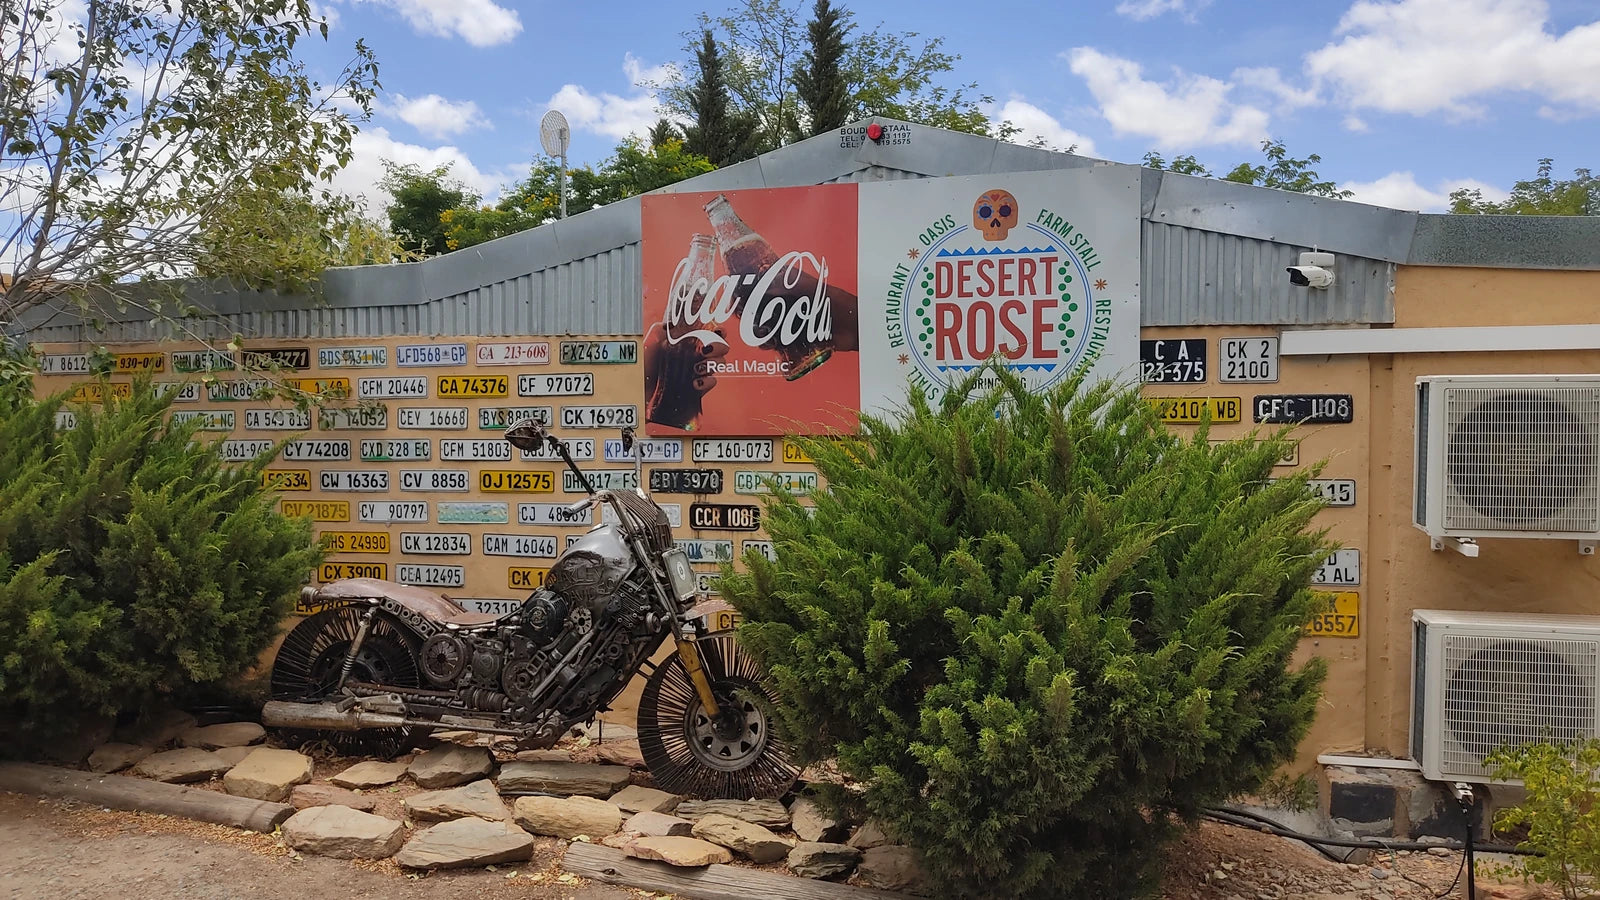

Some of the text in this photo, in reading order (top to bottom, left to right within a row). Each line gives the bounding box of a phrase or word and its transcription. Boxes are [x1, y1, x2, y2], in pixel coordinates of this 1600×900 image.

[883, 124, 911, 133] STAAL
[918, 213, 956, 247] OASIS
[1036, 208, 1102, 273] FARM STALL
[935, 256, 1059, 299] DESERT
[660, 250, 833, 347] Coca-Cola
[885, 262, 911, 349] RESTAURANT
[935, 299, 1059, 361] ROSE
[320, 351, 341, 365] BDS
[371, 350, 386, 364] NC
[398, 347, 466, 363] LFD568 GP
[478, 345, 547, 360] CA 213-608
[562, 343, 635, 360] FXZ436 NW
[1227, 341, 1269, 359] CK 2
[706, 360, 790, 375] Real Magic
[1141, 361, 1204, 382] 123-375
[1227, 360, 1270, 378] 2100
[232, 381, 252, 397] 086
[361, 379, 425, 396] CFM 20446
[440, 378, 507, 394] CA 74376
[519, 376, 592, 394] CF 97072
[1217, 401, 1237, 418] WB
[1311, 398, 1350, 418] 1108
[221, 413, 235, 427] NC
[246, 412, 260, 427] CA
[400, 408, 466, 426] CEY 16668
[482, 409, 505, 427] BYS
[564, 408, 634, 425] CK 16928
[284, 441, 349, 457] CY 74208
[361, 442, 430, 457] CXD 328 EC
[443, 441, 510, 458] CFM 51803
[576, 442, 593, 457] FS
[663, 442, 680, 458] GP
[694, 441, 772, 459] CF 160-073
[785, 443, 802, 459] CA
[320, 472, 388, 488] CW 16363
[403, 472, 466, 488] CV 8858
[482, 471, 551, 489] OJ 12575
[622, 472, 638, 488] FS
[682, 471, 720, 488] 3970
[737, 473, 761, 489] CBP
[798, 475, 815, 490] NC
[284, 504, 347, 519] CV 21875
[361, 503, 425, 518] CY 90797
[520, 506, 537, 522] CJ
[694, 507, 721, 527] CCR
[727, 508, 756, 527] 1081
[350, 535, 386, 550] 24990
[404, 536, 467, 551] CK 12834
[485, 538, 509, 553] CAM
[515, 540, 554, 555] 16046
[324, 565, 381, 581] CX 3900
[400, 568, 461, 584] CEA 12495
[511, 571, 531, 586] CK
[1333, 568, 1355, 583] AL
